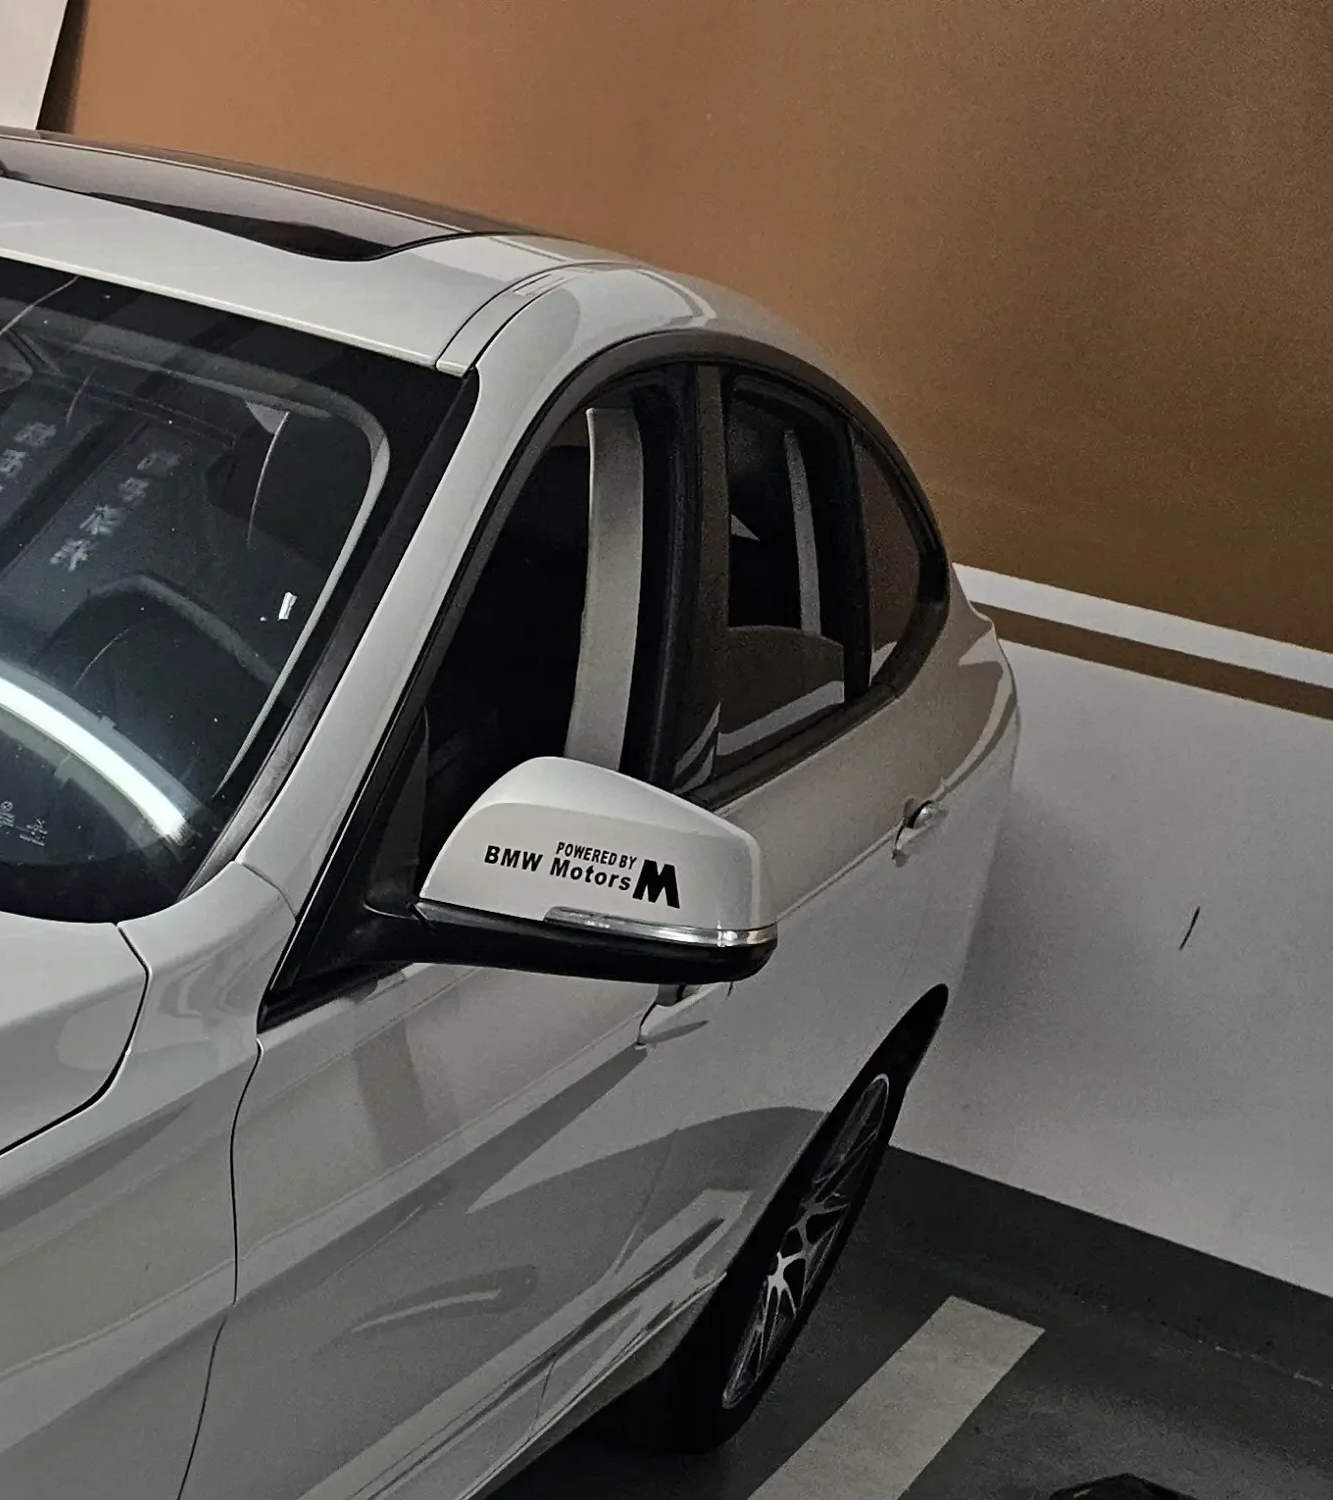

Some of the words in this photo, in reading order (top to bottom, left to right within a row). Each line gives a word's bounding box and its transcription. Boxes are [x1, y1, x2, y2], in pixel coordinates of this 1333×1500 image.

[484, 845, 543, 872] BMW
[549, 857, 632, 891] Motors
[555, 841, 618, 866] POWERED
[618, 853, 638, 870] BY
[632, 859, 681, 909] M
